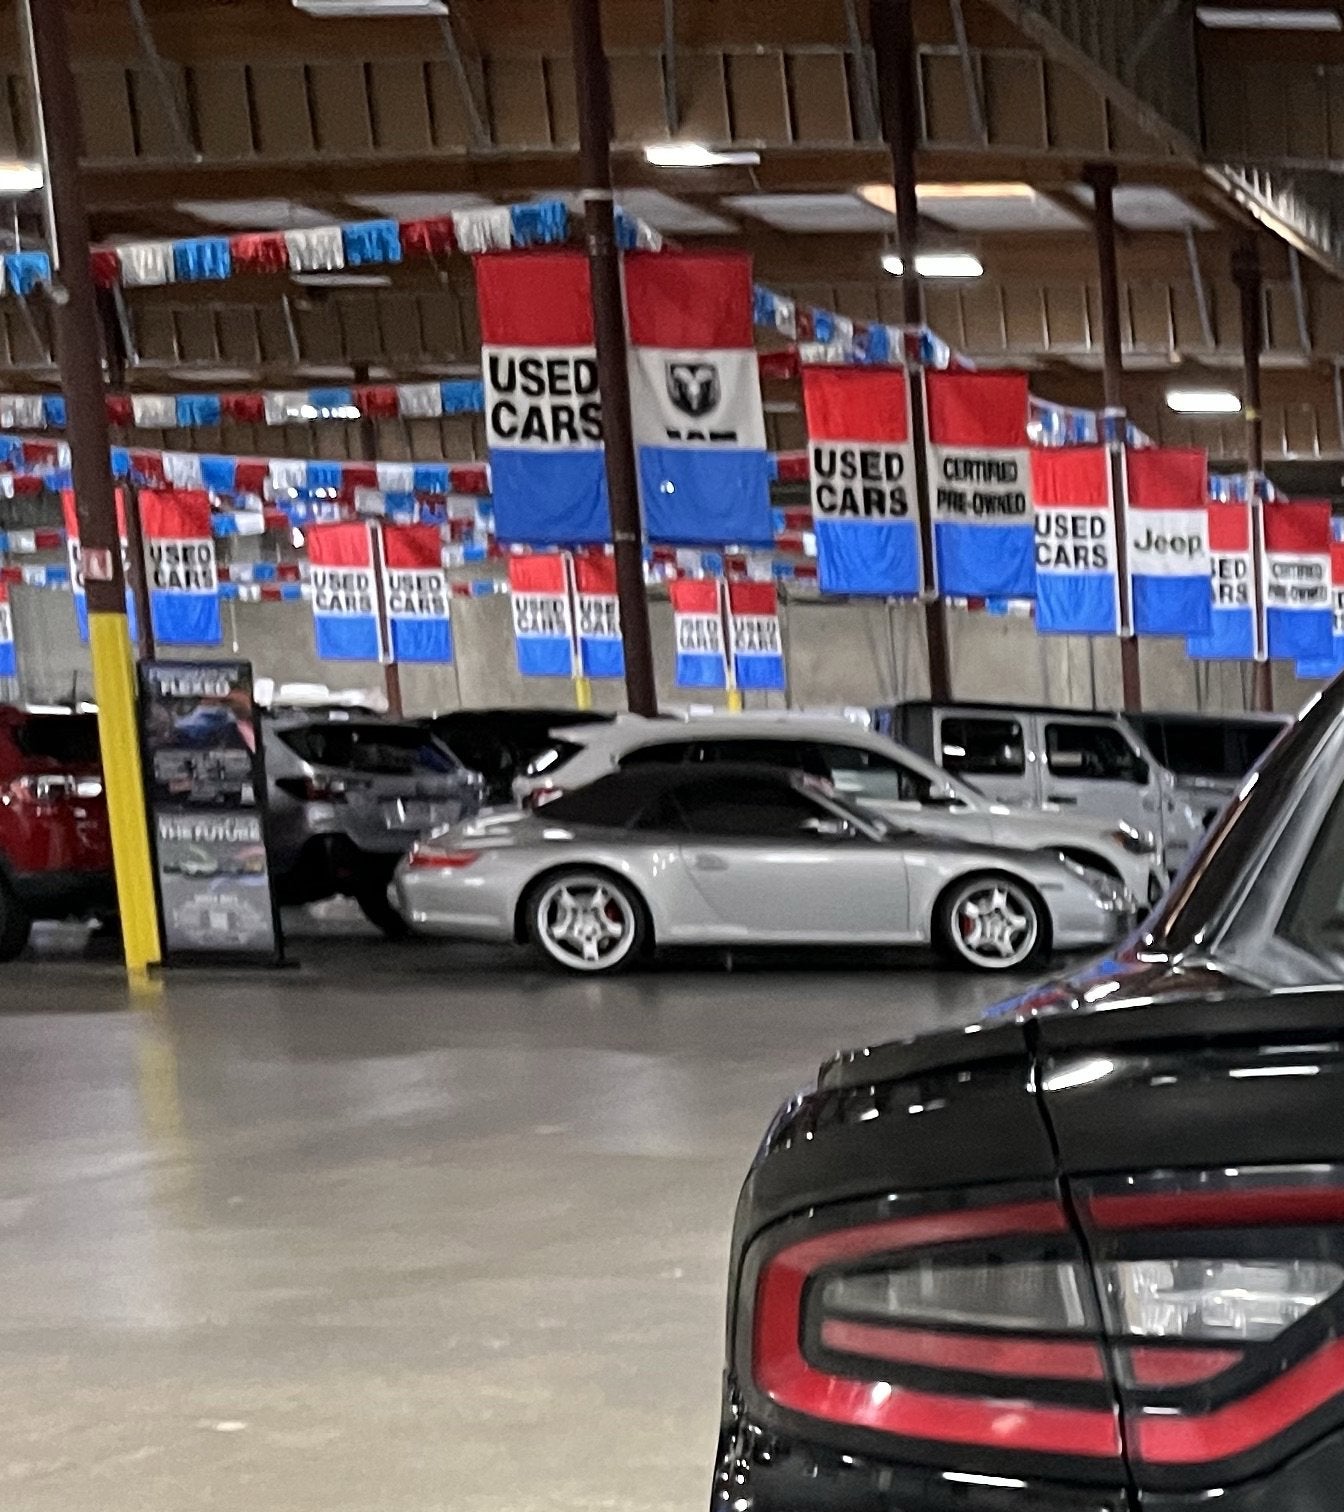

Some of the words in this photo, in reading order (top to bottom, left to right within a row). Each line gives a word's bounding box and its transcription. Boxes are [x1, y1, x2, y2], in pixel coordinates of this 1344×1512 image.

[488, 354, 599, 396] USED
[491, 400, 602, 441] CARS
[814, 448, 905, 482] USED
[943, 457, 1019, 482] CERTIFIED
[815, 485, 909, 517] CARS
[936, 488, 1027, 517] PRE-OWNED
[1034, 513, 1107, 540] USED
[1035, 542, 1109, 568] CARS
[1133, 527, 1204, 560] Jeep
